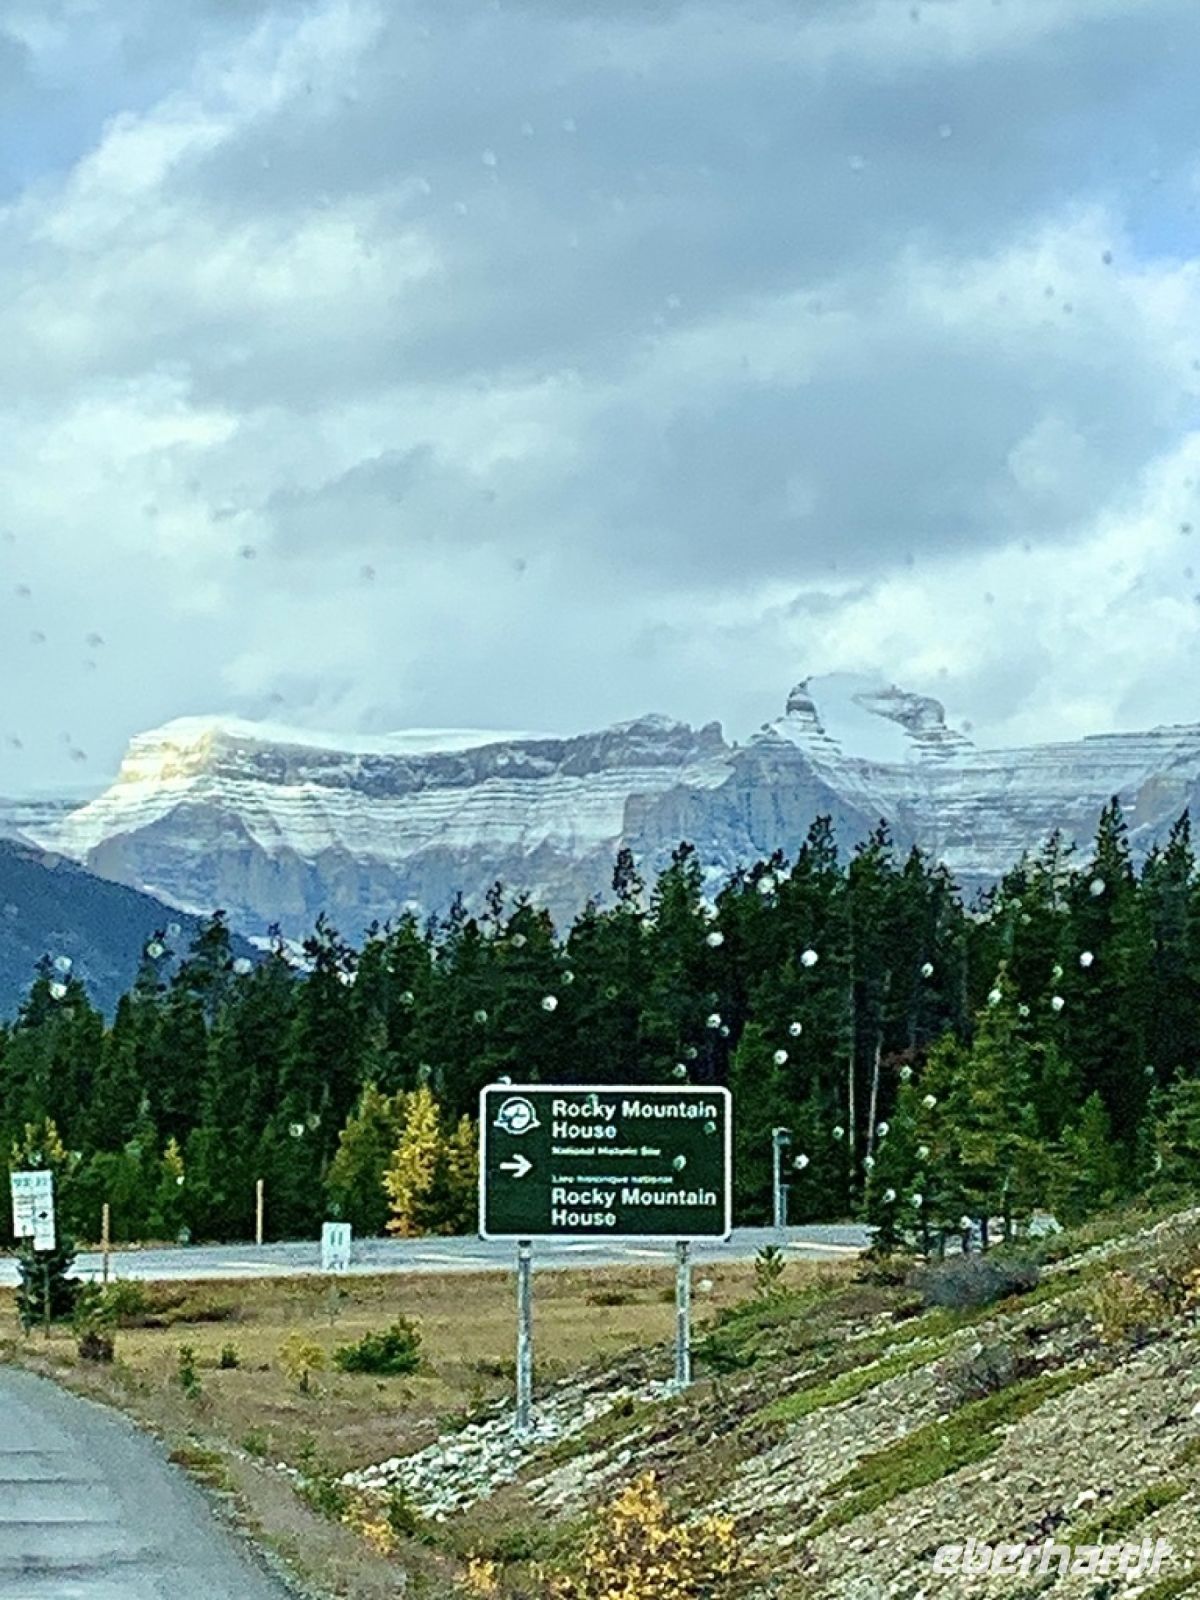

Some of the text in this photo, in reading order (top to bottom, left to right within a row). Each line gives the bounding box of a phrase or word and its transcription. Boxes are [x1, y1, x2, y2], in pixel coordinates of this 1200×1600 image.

[552, 1100, 717, 1121] Rocky Mountain
[552, 1122, 616, 1139] House
[552, 1187, 717, 1208] Rocky Mountain
[552, 1209, 616, 1226] House
